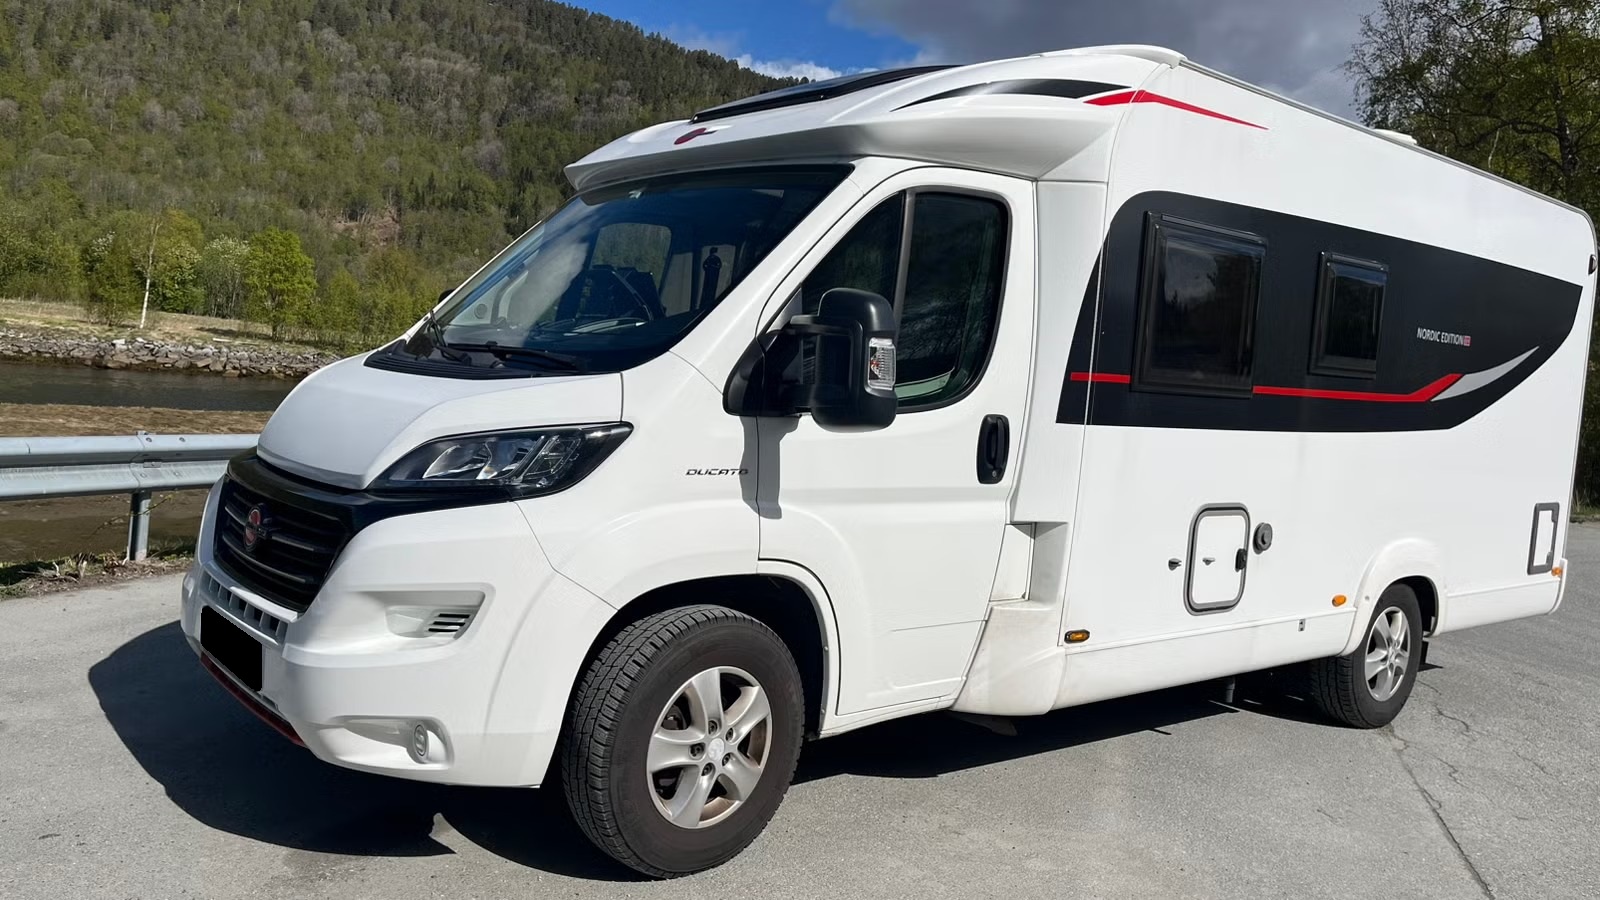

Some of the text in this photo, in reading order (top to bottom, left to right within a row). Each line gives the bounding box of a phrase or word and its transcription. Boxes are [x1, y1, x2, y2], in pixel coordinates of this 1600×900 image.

[1416, 327, 1441, 342] NORDIC
[1441, 332, 1464, 345] EDITION
[685, 468, 749, 476] DUCATO
